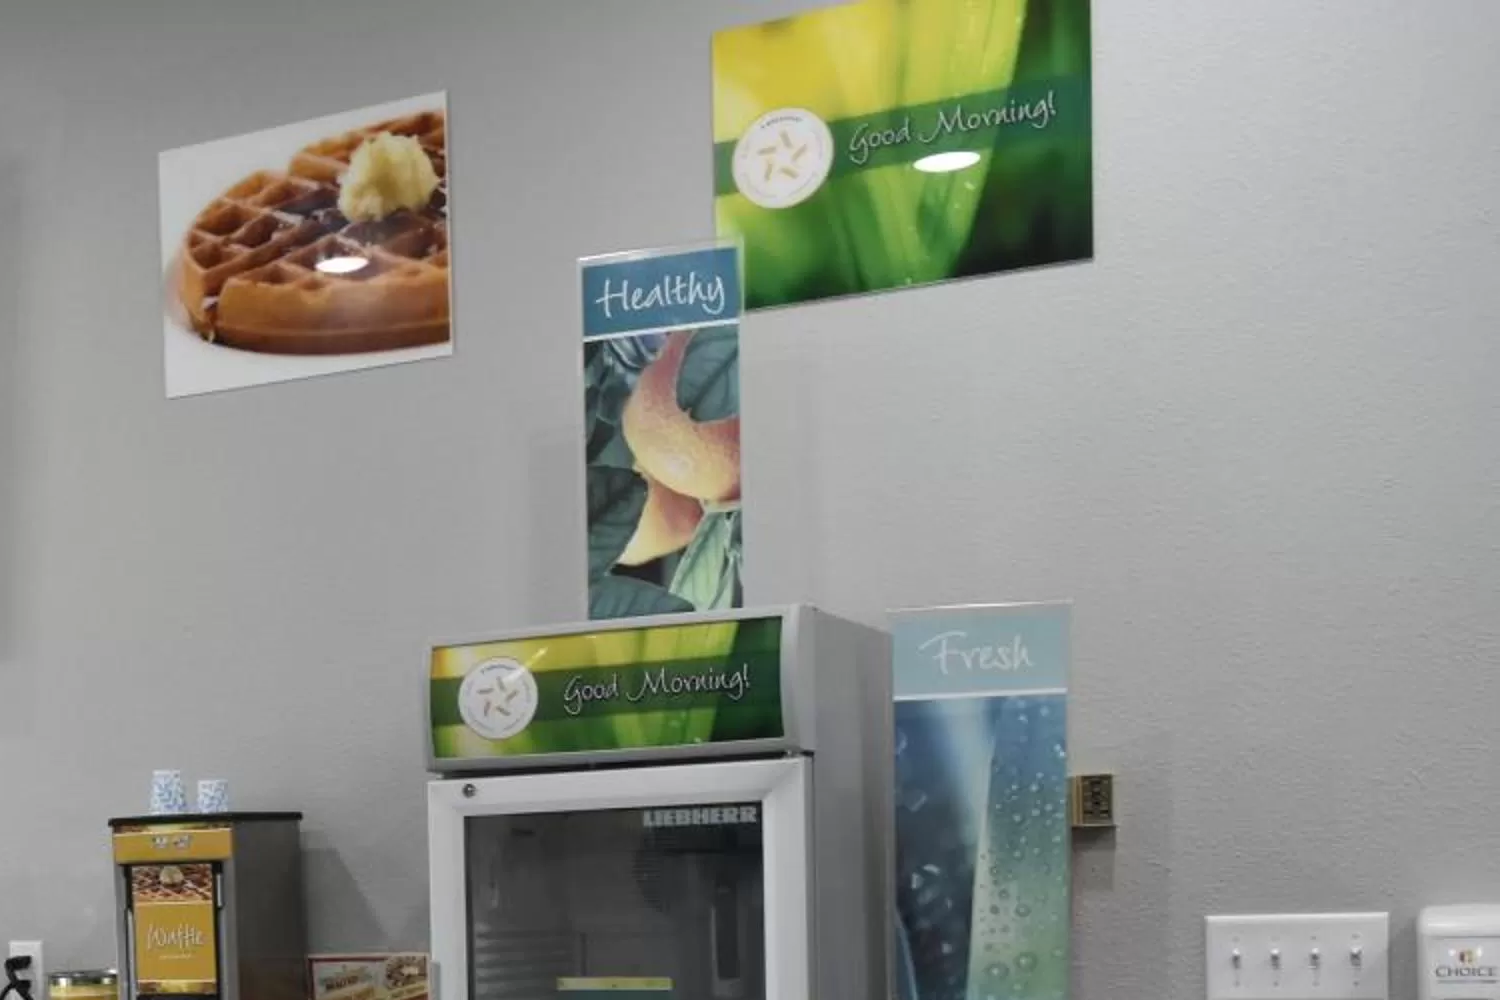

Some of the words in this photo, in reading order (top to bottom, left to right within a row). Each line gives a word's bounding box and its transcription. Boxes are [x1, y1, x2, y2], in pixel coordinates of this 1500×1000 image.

[849, 115, 910, 165] Good
[918, 90, 1057, 143] Morning!
[594, 271, 726, 319] Healthy
[916, 629, 1038, 675] Fresh
[563, 672, 619, 715] Good
[625, 662, 750, 701] Morning!
[642, 805, 758, 827] LIEBHERR
[1435, 965, 1498, 978] CHOICE
